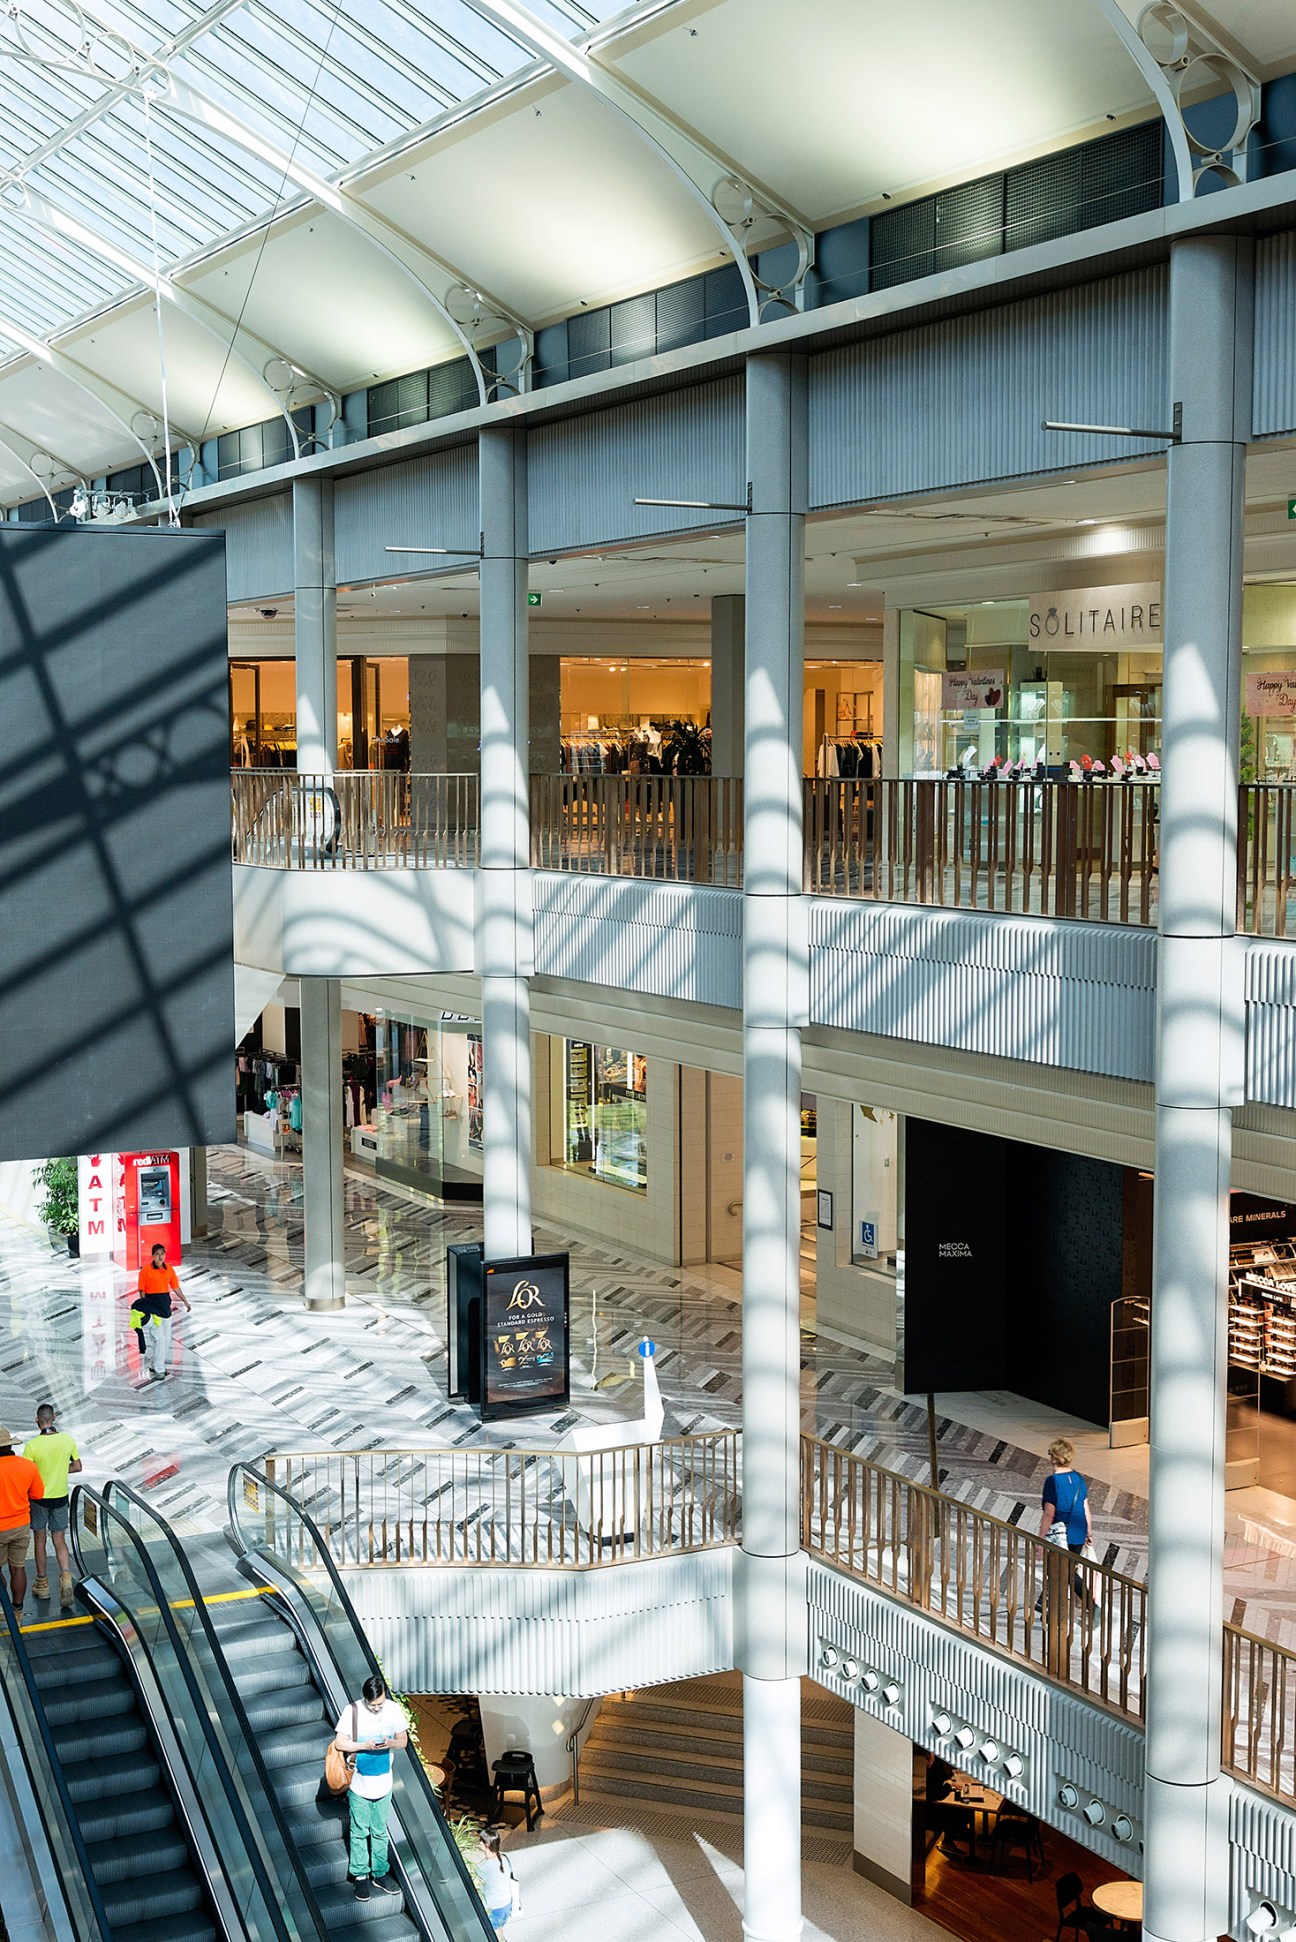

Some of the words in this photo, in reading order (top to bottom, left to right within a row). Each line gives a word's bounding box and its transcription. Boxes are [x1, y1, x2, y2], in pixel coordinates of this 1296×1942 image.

[1029, 603, 1160, 638] SOLITAIRE
[948, 678, 968, 689] Happy
[1256, 677, 1283, 692] Happy
[963, 689, 979, 707] Day
[1277, 693, 1296, 713] Day
[88, 1175, 104, 1235] ATM
[1245, 1210, 1287, 1222] MINERALS
[938, 1242, 970, 1250] MECCA
[1245, 1272, 1274, 1287] MECCA
[497, 1319, 526, 1328] STANDARD
[527, 1316, 555, 1324] ESPRESSO
